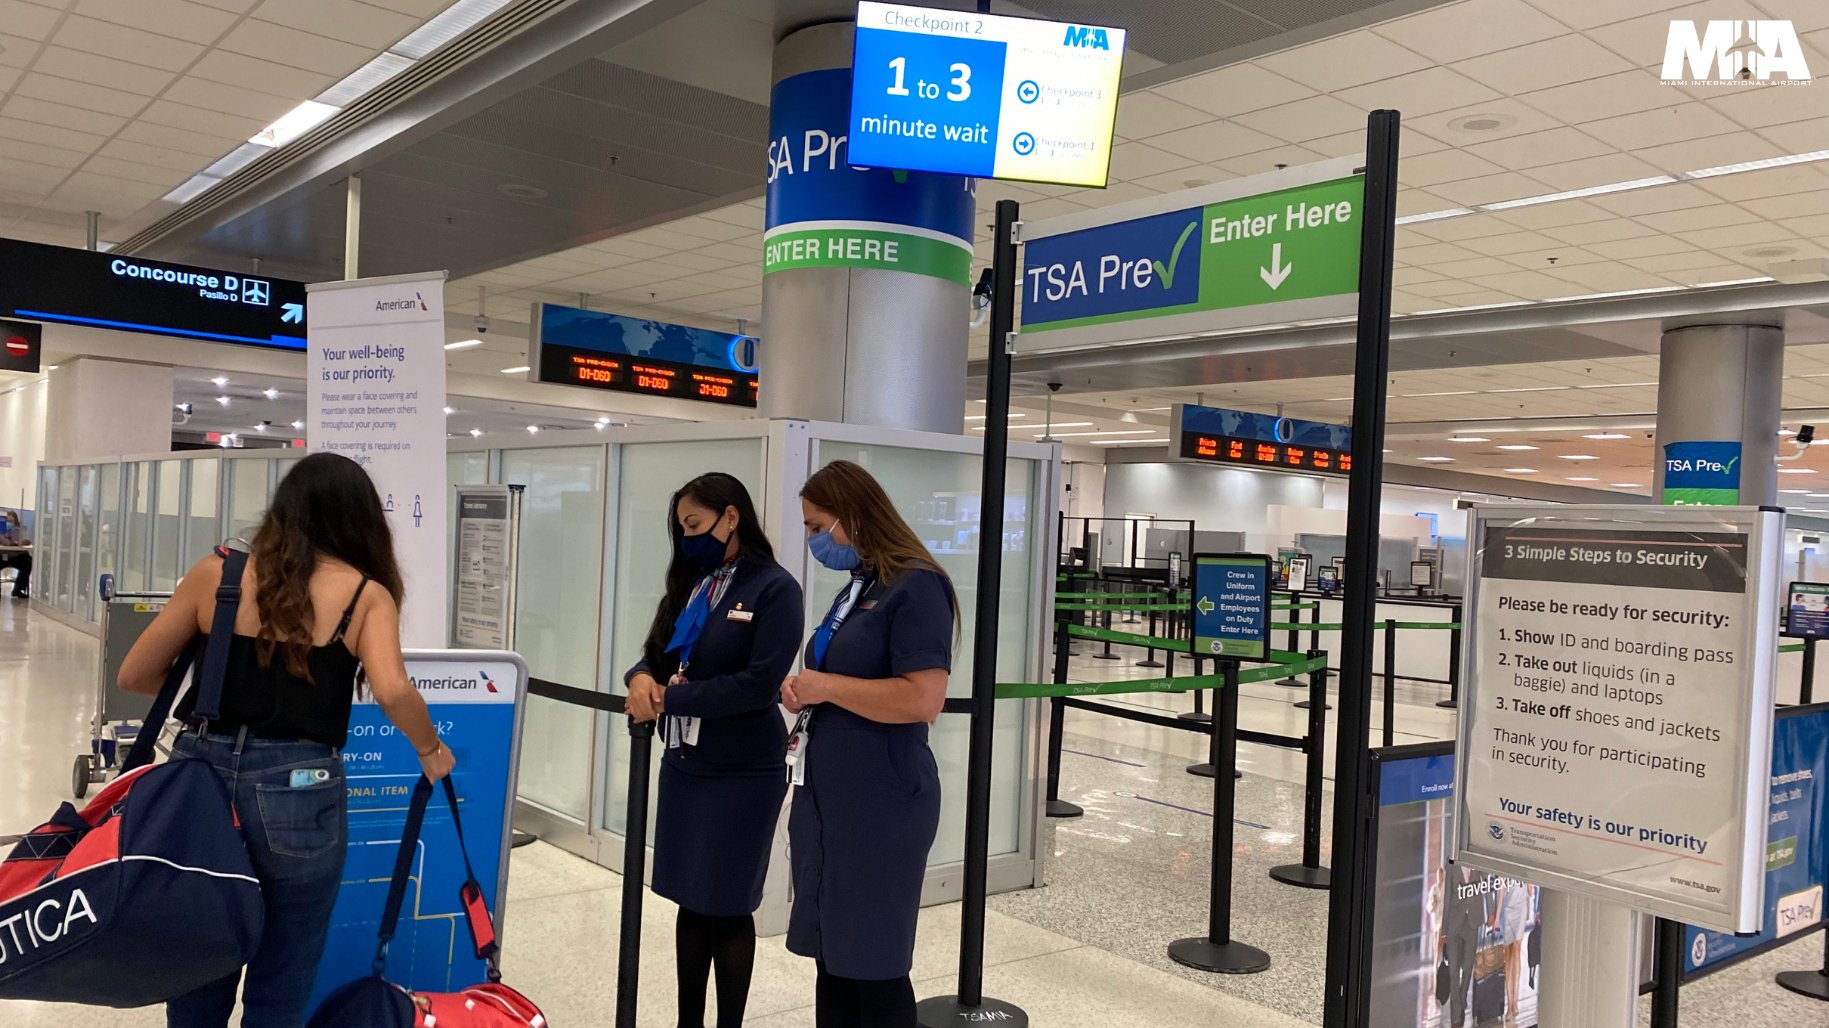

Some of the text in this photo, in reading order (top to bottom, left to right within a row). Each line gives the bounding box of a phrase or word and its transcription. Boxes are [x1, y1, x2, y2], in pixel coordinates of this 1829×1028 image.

[885, 10, 984, 34] Checkpoint 2
[886, 56, 972, 102] 1 to 3
[860, 114, 989, 144] minute wait
[1210, 200, 1352, 244] Enter Here
[766, 238, 899, 267] ENTER HERE
[110, 259, 238, 290] Concourse D
[1028, 254, 1152, 303] TSA Pre
[200, 289, 238, 302] Pasillo D
[376, 298, 416, 312] American
[322, 344, 405, 362] Your well-being
[322, 366, 396, 384] is our priority.
[322, 393, 340, 401] Please
[362, 391, 378, 400] face
[379, 392, 404, 402] covering
[405, 390, 418, 400] and
[348, 407, 366, 416] space
[367, 406, 396, 414] between
[396, 406, 416, 414] others
[321, 421, 354, 430] throughout
[354, 422, 371, 431] your
[321, 441, 411, 452] A face covering is required on
[1666, 460, 1722, 472] TSA Pre
[1504, 544, 1709, 570] 3 Simple Steps to Security
[1227, 571, 1254, 579] Crew in
[1226, 582, 1255, 590] Uniform
[1235, 594, 1260, 602] Airport
[1220, 604, 1260, 614] Employees
[1498, 596, 1730, 629] Please be ready for security:
[1236, 615, 1254, 624] Duty
[1242, 626, 1259, 634] Here
[1499, 628, 1734, 664] 1. Show ID and boarding pass
[1498, 652, 1676, 686] 2. Take out liquids (in a
[409, 676, 477, 690] American
[1514, 673, 1664, 706] baggie) and laptops
[1496, 697, 1721, 742] 3. Take off shoes and jackets
[1492, 746, 1570, 774] in security.
[1494, 728, 1706, 779] Thank you for participating
[381, 786, 408, 796] ITEM
[1422, 784, 1438, 792] Enroll
[1499, 798, 1707, 854] Your safety is our priority
[1510, 827, 1556, 842] Transportation
[1456, 874, 1491, 900] travel
[1670, 876, 1722, 895] www.tsa.gov
[1780, 908, 1796, 930] TSA
